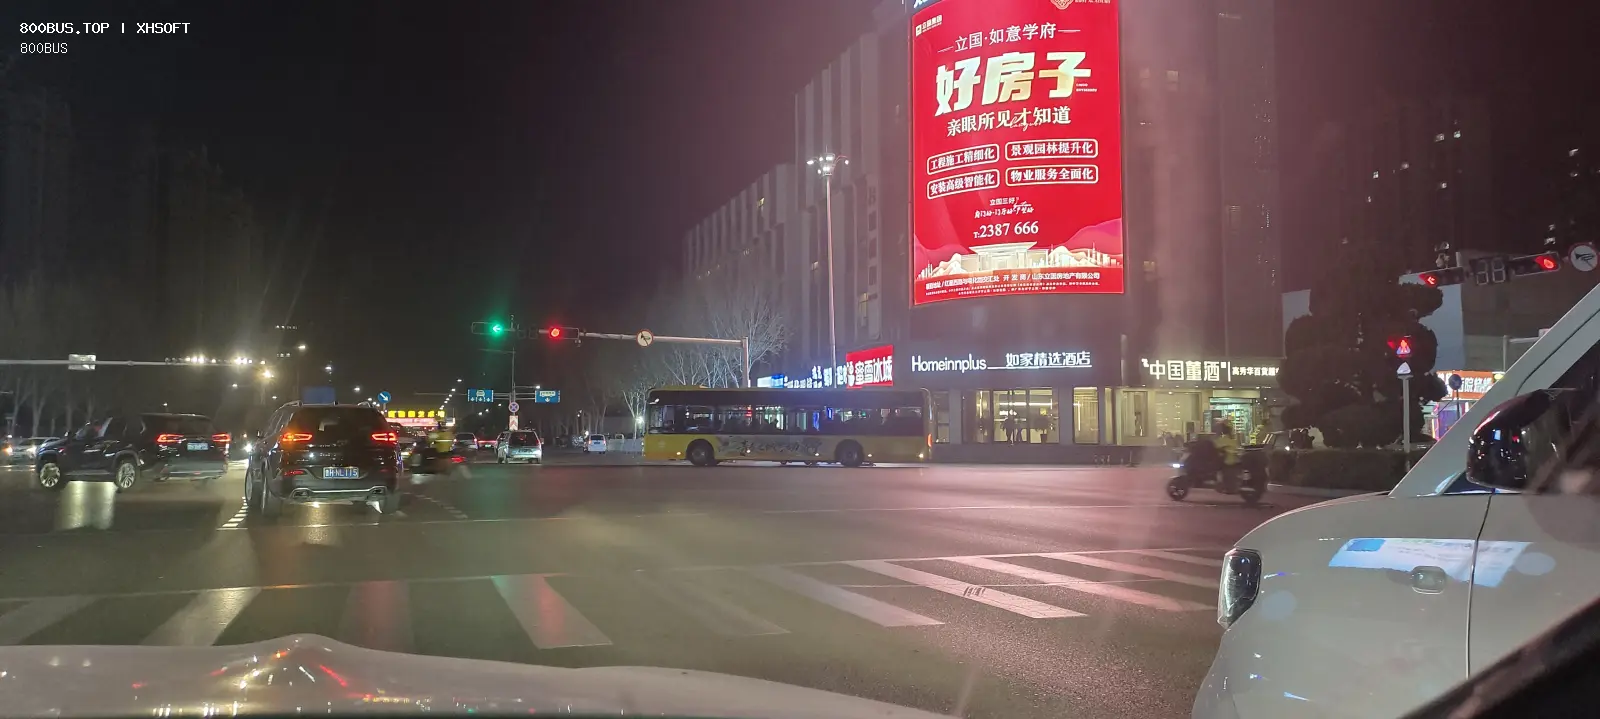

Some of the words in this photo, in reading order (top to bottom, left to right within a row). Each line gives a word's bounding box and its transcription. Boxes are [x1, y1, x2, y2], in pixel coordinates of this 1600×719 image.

[935, 52, 1092, 117] 好房子
[947, 105, 1072, 137] 亲眼所见才知道
[929, 147, 996, 171] 工程施工精细化
[1010, 141, 1094, 157] 景观园林提升化
[929, 172, 996, 196] 安装高级智能化
[1010, 167, 1094, 183] 物业服务全面化
[1013, 220, 1039, 235] 666
[854, 355, 893, 386] 蜜雪冰城
[911, 353, 987, 374] Homeinnplus
[1005, 351, 1092, 368] 如家精选酒店
